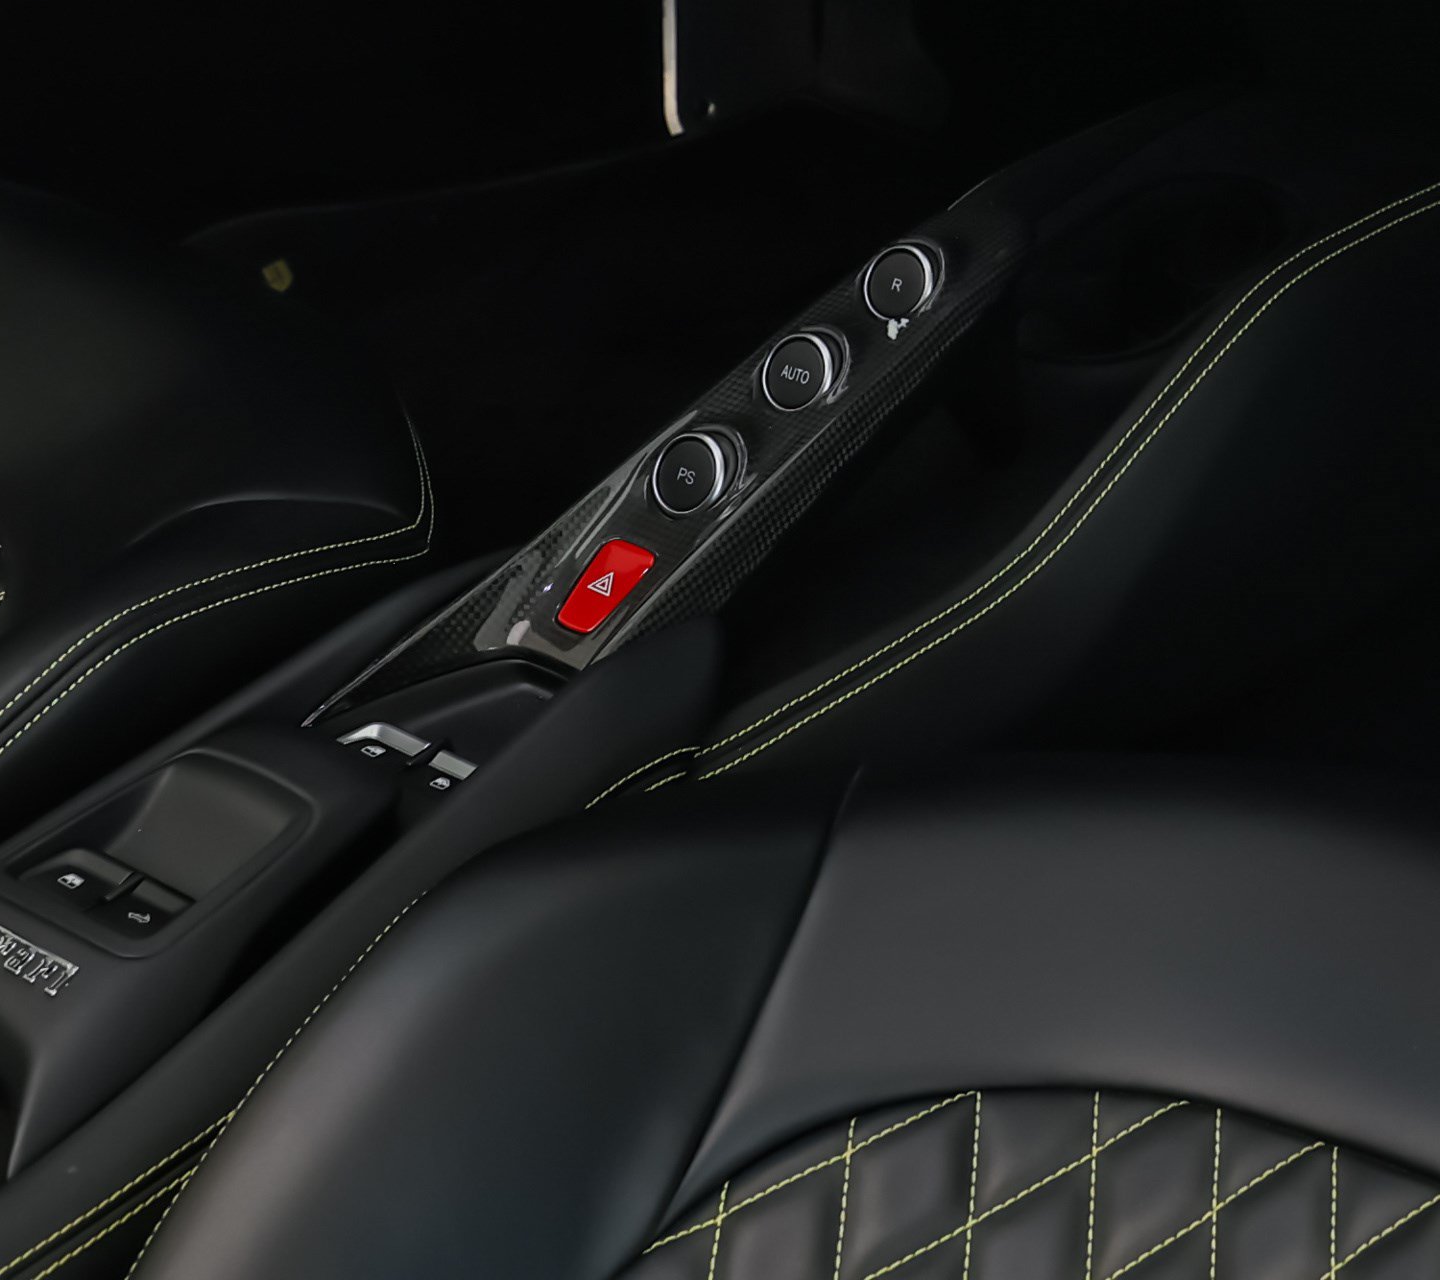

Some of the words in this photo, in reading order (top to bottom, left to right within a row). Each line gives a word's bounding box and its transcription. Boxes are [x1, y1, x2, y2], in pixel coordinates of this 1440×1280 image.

[891, 278, 902, 291] R
[780, 364, 810, 384] AUTO
[676, 467, 696, 484] PS
